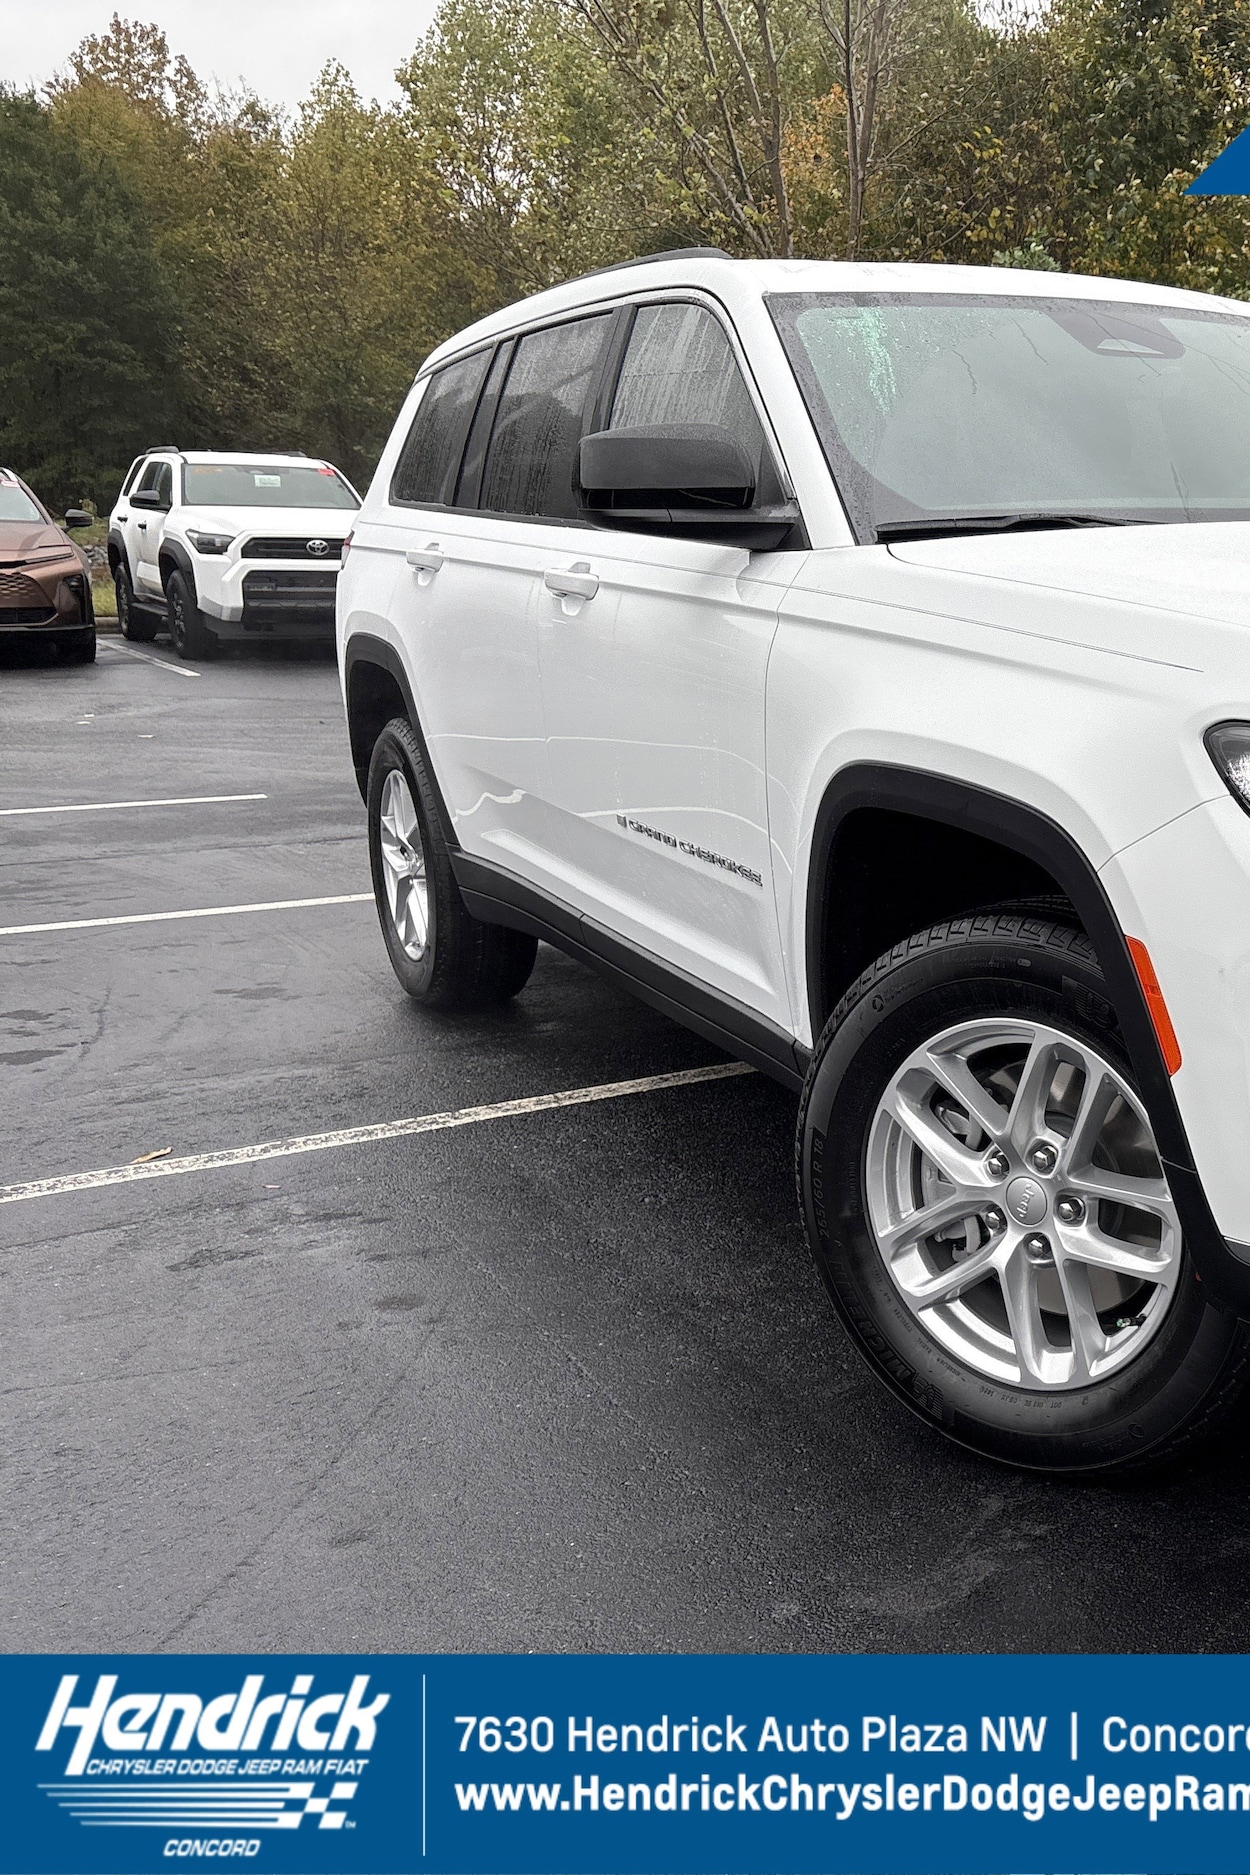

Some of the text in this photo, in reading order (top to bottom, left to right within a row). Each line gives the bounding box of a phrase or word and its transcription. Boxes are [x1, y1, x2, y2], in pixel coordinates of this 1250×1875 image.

[628, 818, 764, 888] GRAND CHEROKEE
[812, 1138, 831, 1239] 265/60 R 18
[1015, 1182, 1035, 1218] Jeep
[829, 1260, 913, 1382] MICHELIN
